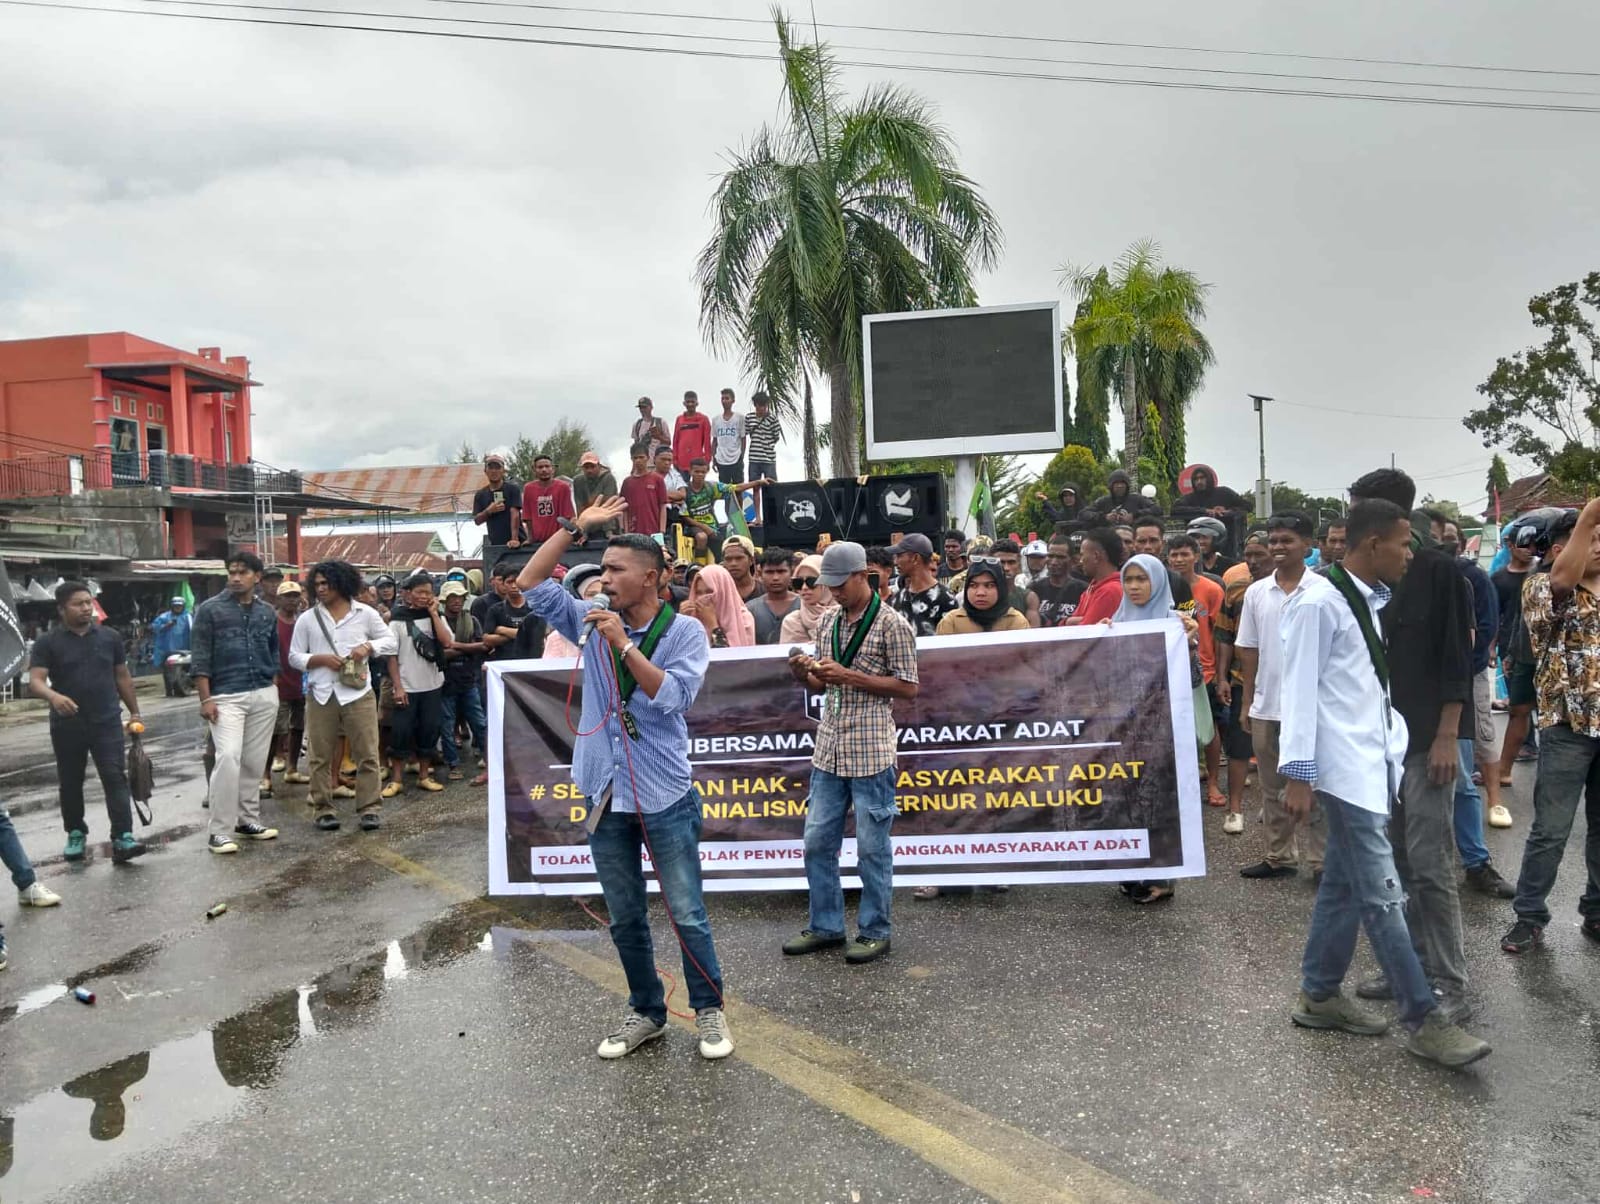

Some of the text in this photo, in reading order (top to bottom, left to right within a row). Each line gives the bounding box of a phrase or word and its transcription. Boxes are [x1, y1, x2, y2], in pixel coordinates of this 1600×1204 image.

[688, 733, 815, 755] BERSAMA
[1014, 720, 1085, 739] ADAT
[732, 777, 787, 795] HAK
[896, 765, 1060, 788] ASYARAKAT
[1068, 761, 1145, 781] ADAT
[985, 789, 1103, 809] MALUKU
[538, 855, 591, 866] TOLAK
[894, 844, 966, 857] ANGKAN
[971, 840, 1089, 854] MASYARAKAT
[1095, 838, 1142, 851] ADAT
